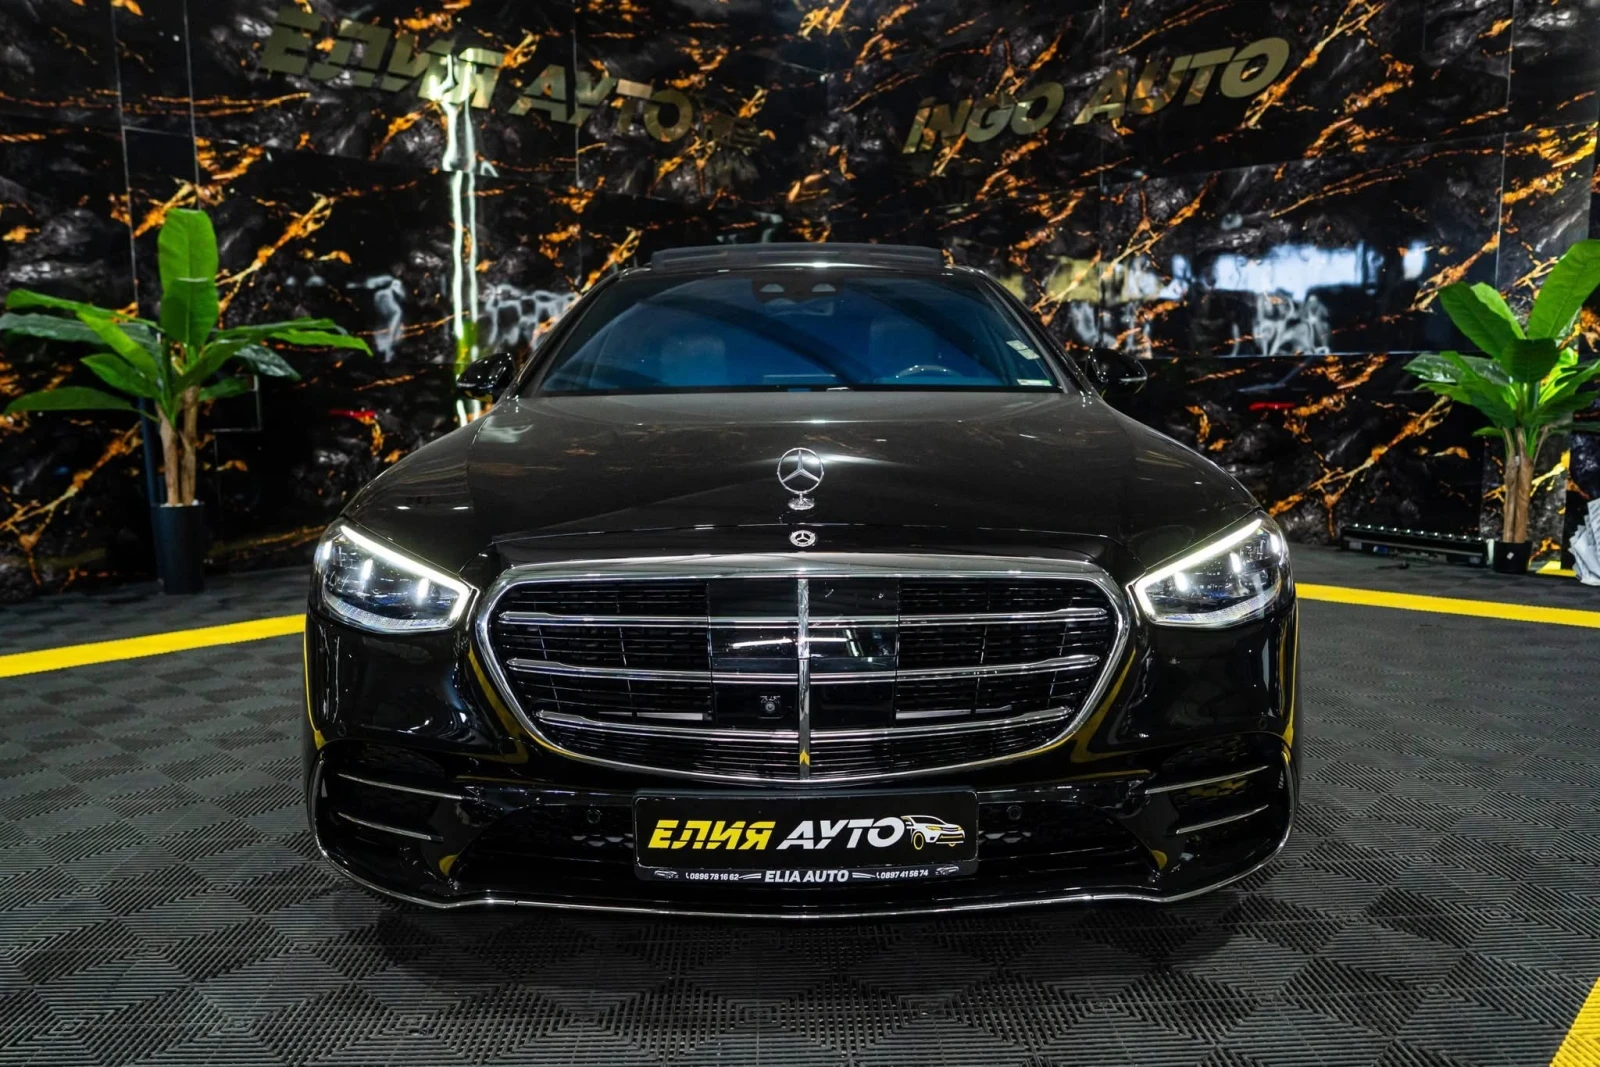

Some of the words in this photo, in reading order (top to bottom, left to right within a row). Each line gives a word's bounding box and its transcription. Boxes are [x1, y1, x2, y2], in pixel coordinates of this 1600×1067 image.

[508, 64, 693, 142] АУТО
[902, 82, 1064, 154] INGO
[1073, 37, 1290, 125] AUTO
[648, 819, 776, 850] ЕЛИЯ
[776, 816, 906, 850] АУТО
[764, 870, 800, 882] ELIA
[802, 869, 849, 882] AUTO
